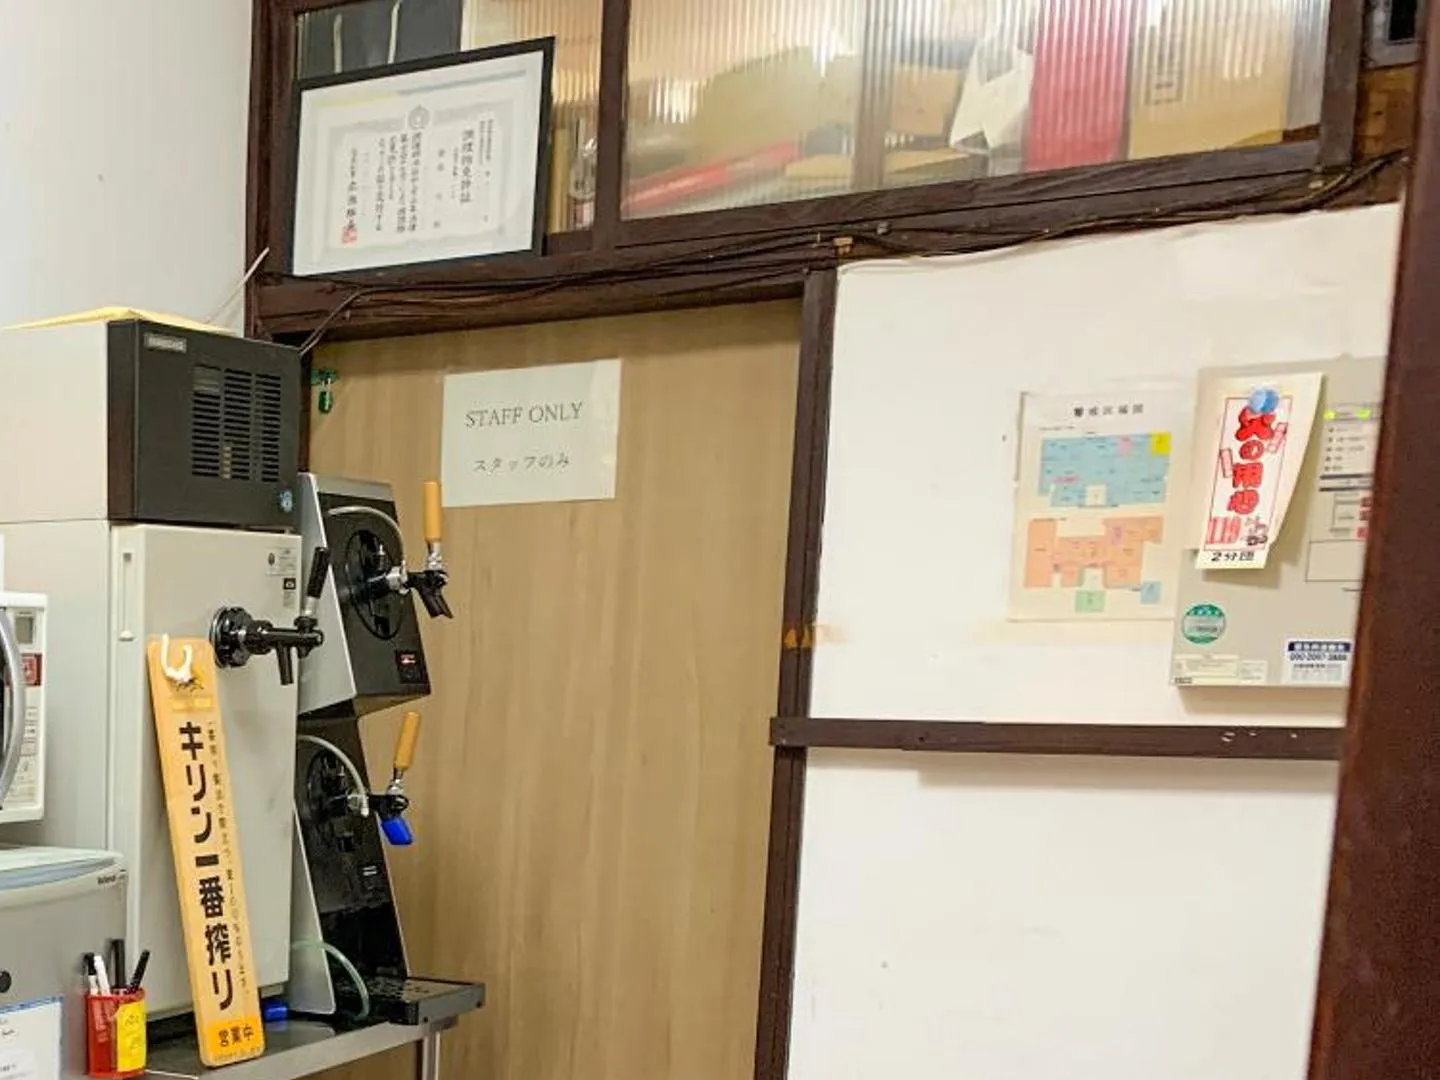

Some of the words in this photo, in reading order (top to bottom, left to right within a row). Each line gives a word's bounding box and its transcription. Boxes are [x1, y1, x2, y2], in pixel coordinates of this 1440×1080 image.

[465, 405, 523, 428] STAFF
[528, 401, 583, 423] ONLY
[178, 721, 234, 1011] キリン一番搾り
